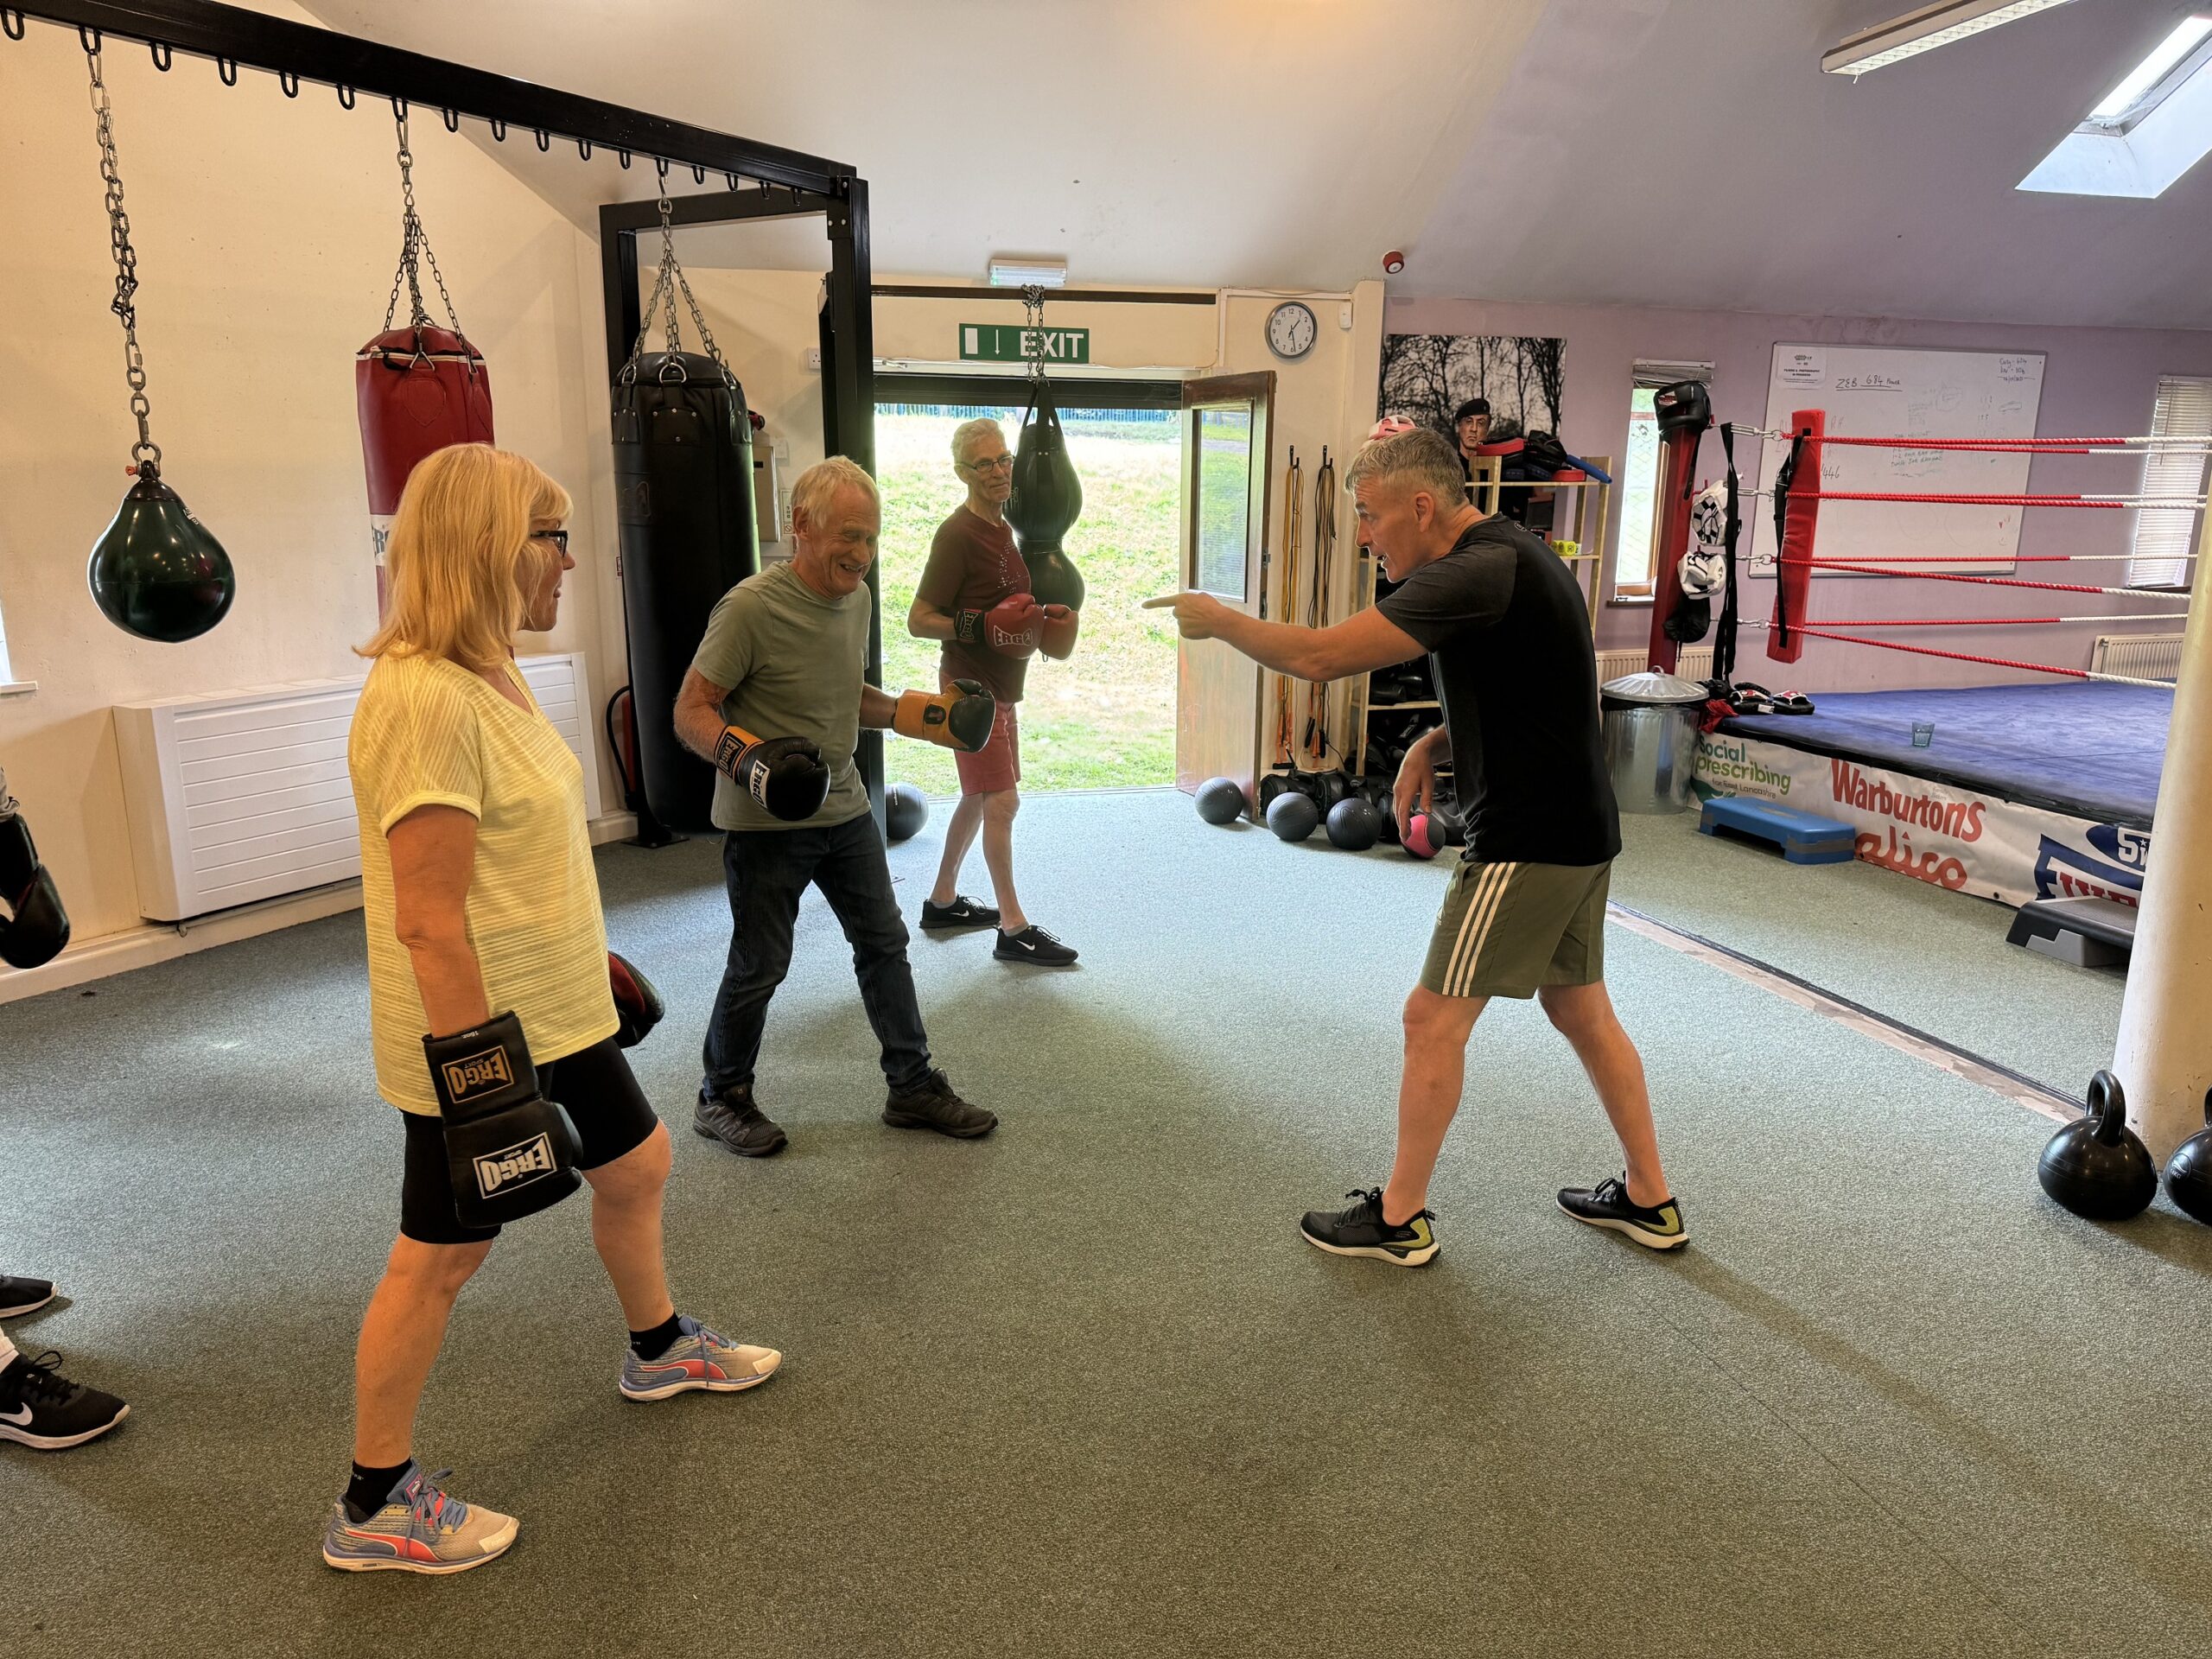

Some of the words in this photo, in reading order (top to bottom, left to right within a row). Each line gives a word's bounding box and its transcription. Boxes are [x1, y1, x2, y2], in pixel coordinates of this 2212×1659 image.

[1020, 331, 1084, 359] EXIT
[719, 739, 740, 771] ERGO
[1699, 734, 1745, 762] Social
[753, 761, 767, 806] ERGO
[1695, 755, 1791, 796] prescribing
[1739, 783, 1777, 799] Lancashire
[1831, 758, 1986, 842] Warburtons
[1855, 825, 1967, 889] alico
[448, 1052, 508, 1094] ERGO
[480, 1137, 551, 1192] ERGO
